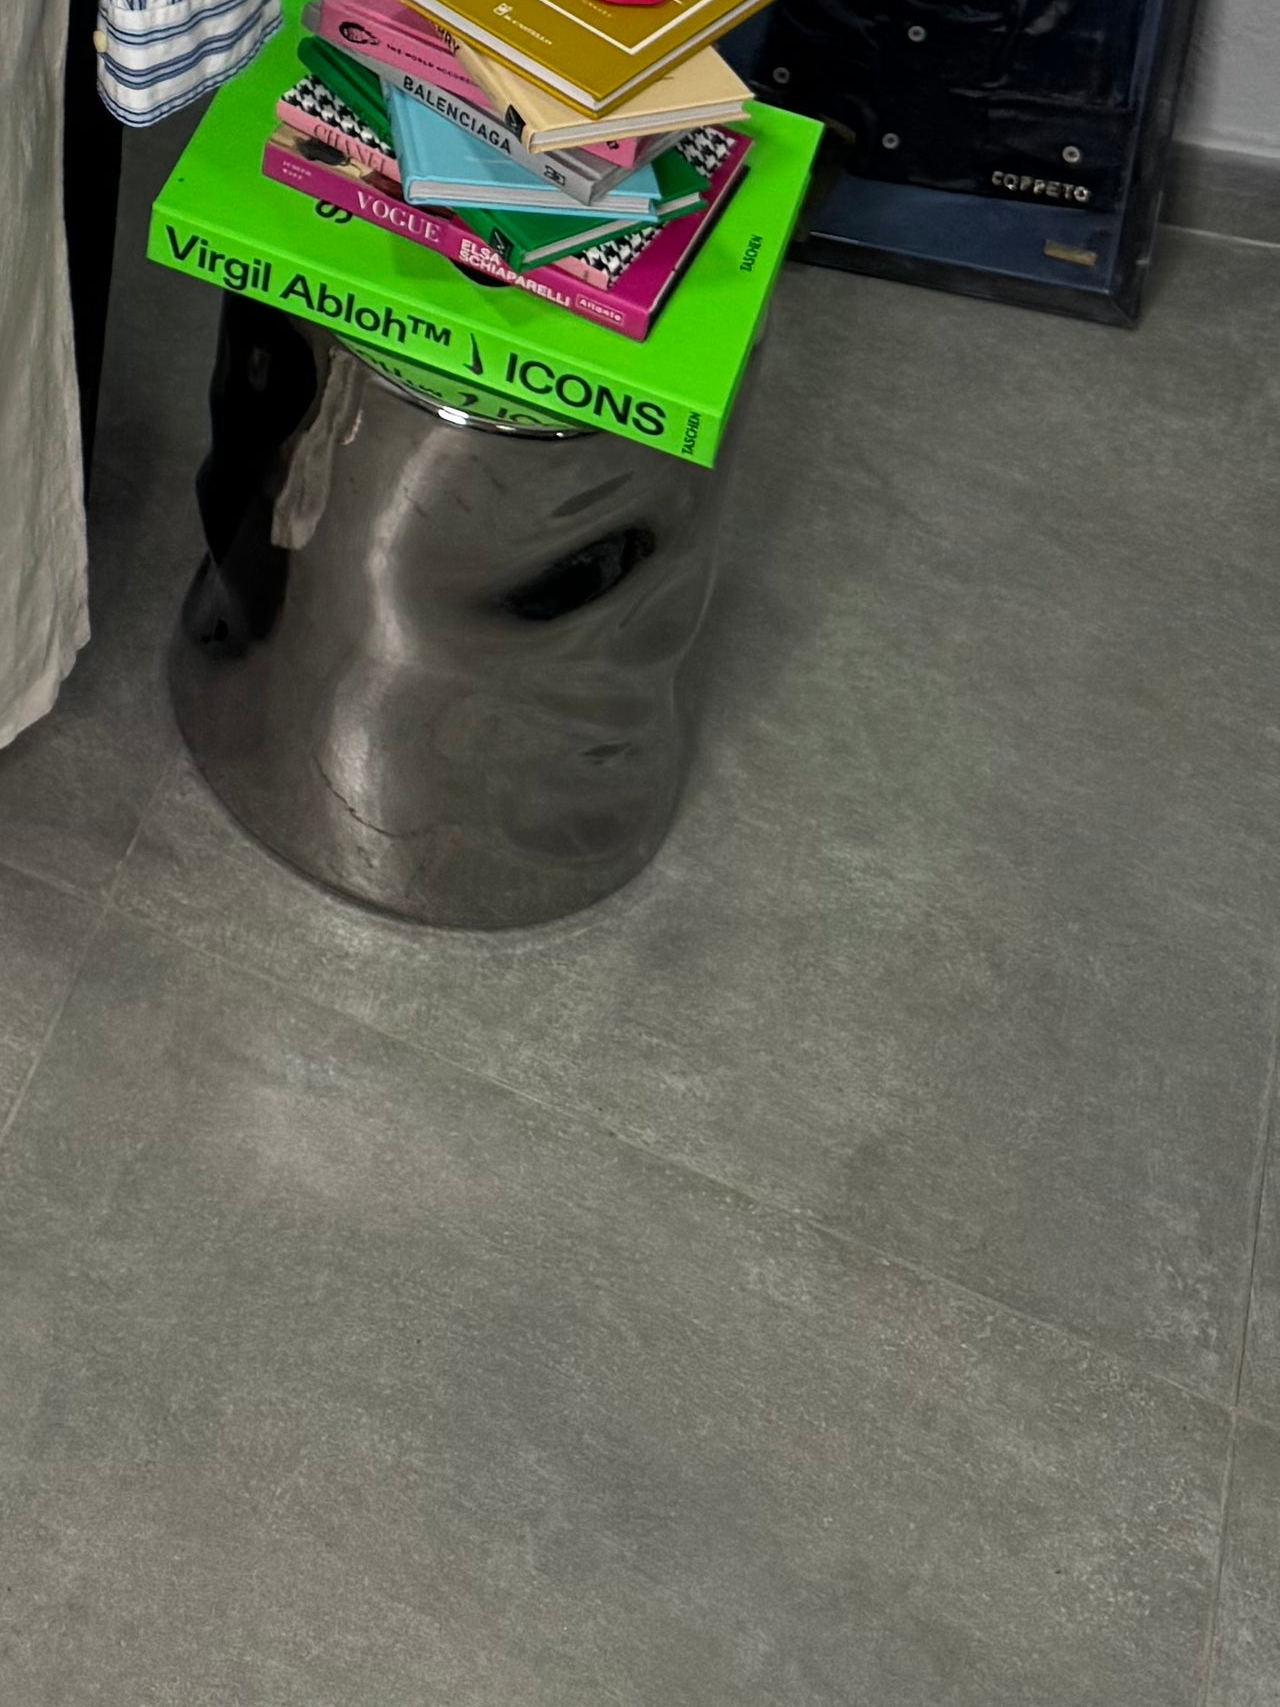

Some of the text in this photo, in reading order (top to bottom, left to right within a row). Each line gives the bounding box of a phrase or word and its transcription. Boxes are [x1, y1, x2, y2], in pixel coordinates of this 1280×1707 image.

[403, 75, 512, 155] BALENCIAGA
[313, 124, 388, 172] CHANEL
[356, 190, 441, 244] VOGUE
[459, 246, 571, 308] SCHIAPARELLI
[461, 238, 501, 266] ELSA
[165, 224, 272, 292] Virgil
[505, 351, 667, 437] ICONS
